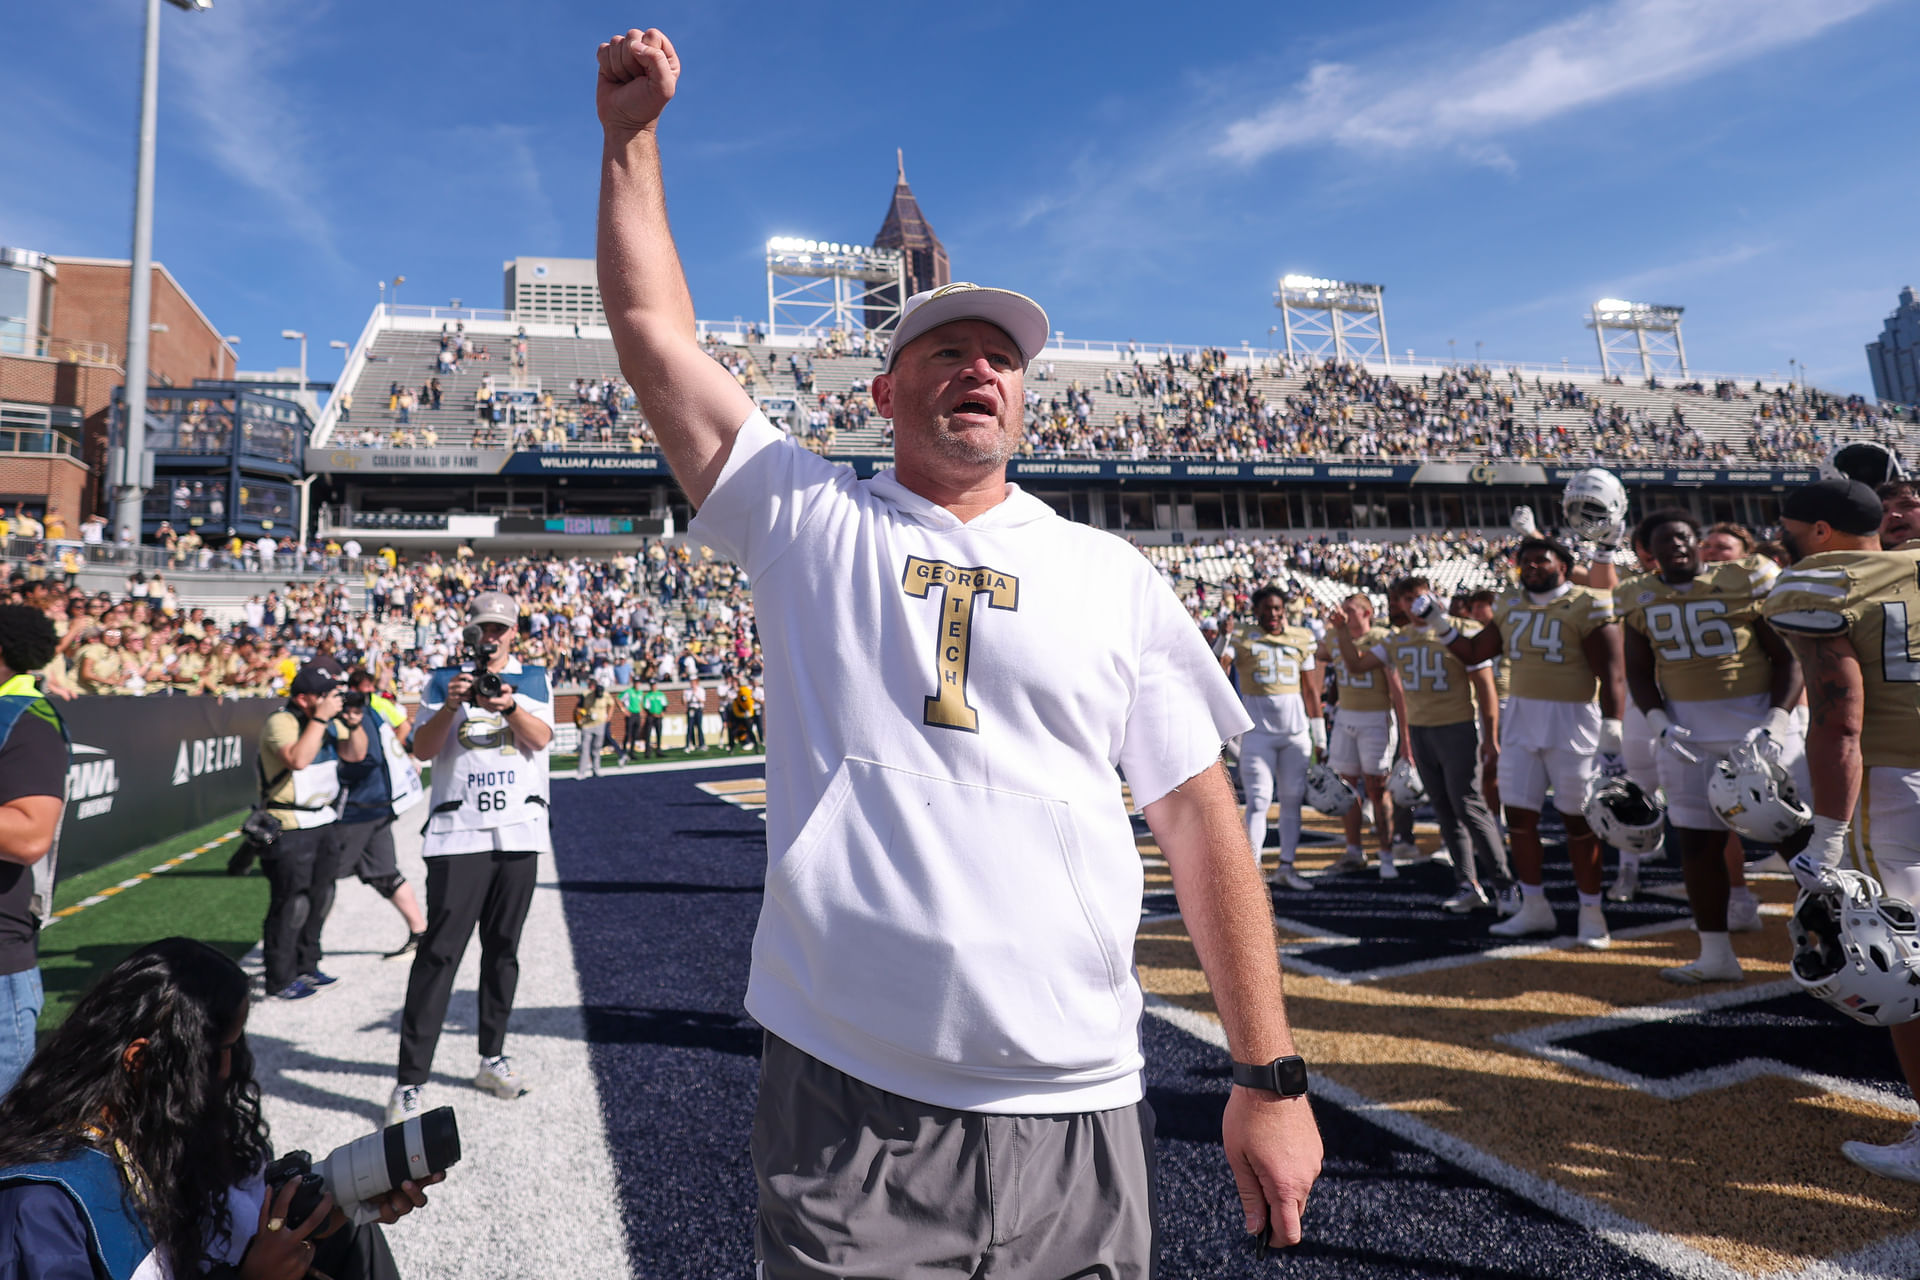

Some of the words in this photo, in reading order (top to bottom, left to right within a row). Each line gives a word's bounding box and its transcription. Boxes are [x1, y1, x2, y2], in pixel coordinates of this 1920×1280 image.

[372, 455, 411, 467] COLLEGE
[414, 455, 436, 467] HALL
[453, 455, 478, 467] FAME
[540, 457, 589, 468] WILLIAM
[590, 458, 658, 469] ALEXANDER
[1017, 463, 1056, 474] EVERETT
[1057, 464, 1100, 474] STRUPPER
[1116, 465, 1134, 475] BILL
[1135, 465, 1172, 475] FINCHER
[916, 565, 1007, 590] GEORGIA
[945, 597, 964, 686] TECH
[1508, 610, 1563, 663] 74
[1645, 600, 1737, 661] 96
[1251, 642, 1299, 685] 35
[1397, 646, 1449, 690] 34
[192, 735, 242, 776] DELTA
[467, 770, 515, 788] PHOTO
[478, 791, 506, 812] 66
